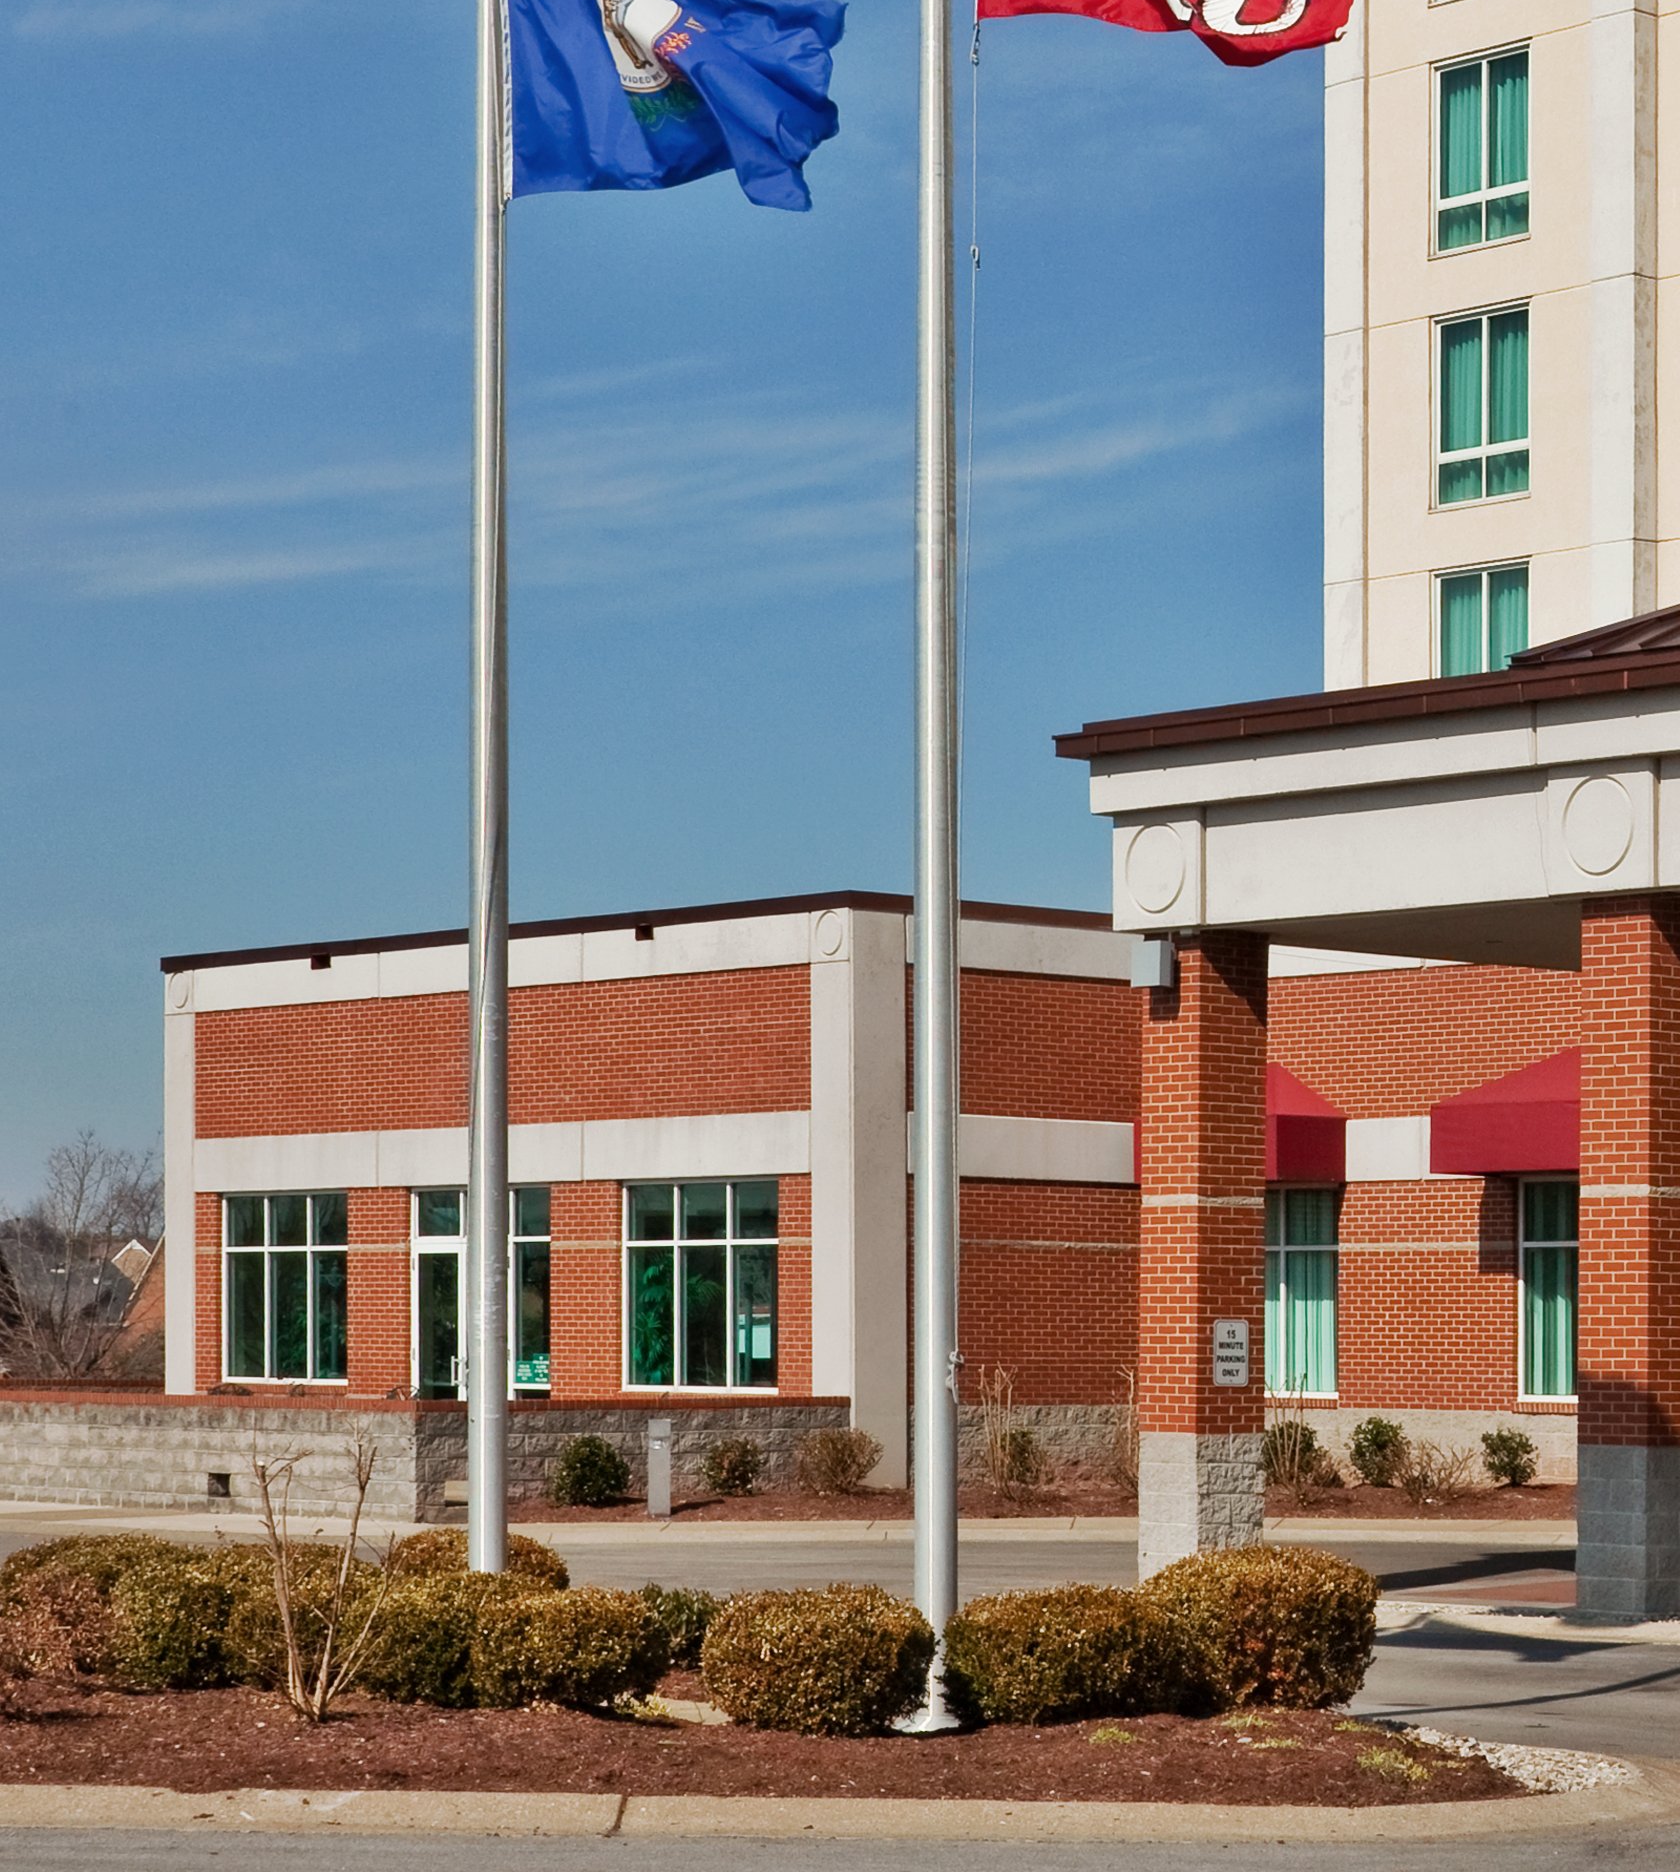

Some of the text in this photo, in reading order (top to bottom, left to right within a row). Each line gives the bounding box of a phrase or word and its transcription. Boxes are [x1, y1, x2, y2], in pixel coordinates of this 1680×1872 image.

[1227, 1330, 1236, 1339] 15
[1218, 1342, 1243, 1350] MINUTE
[1216, 1355, 1245, 1363] PARKING
[1222, 1368, 1240, 1377] ONLY
